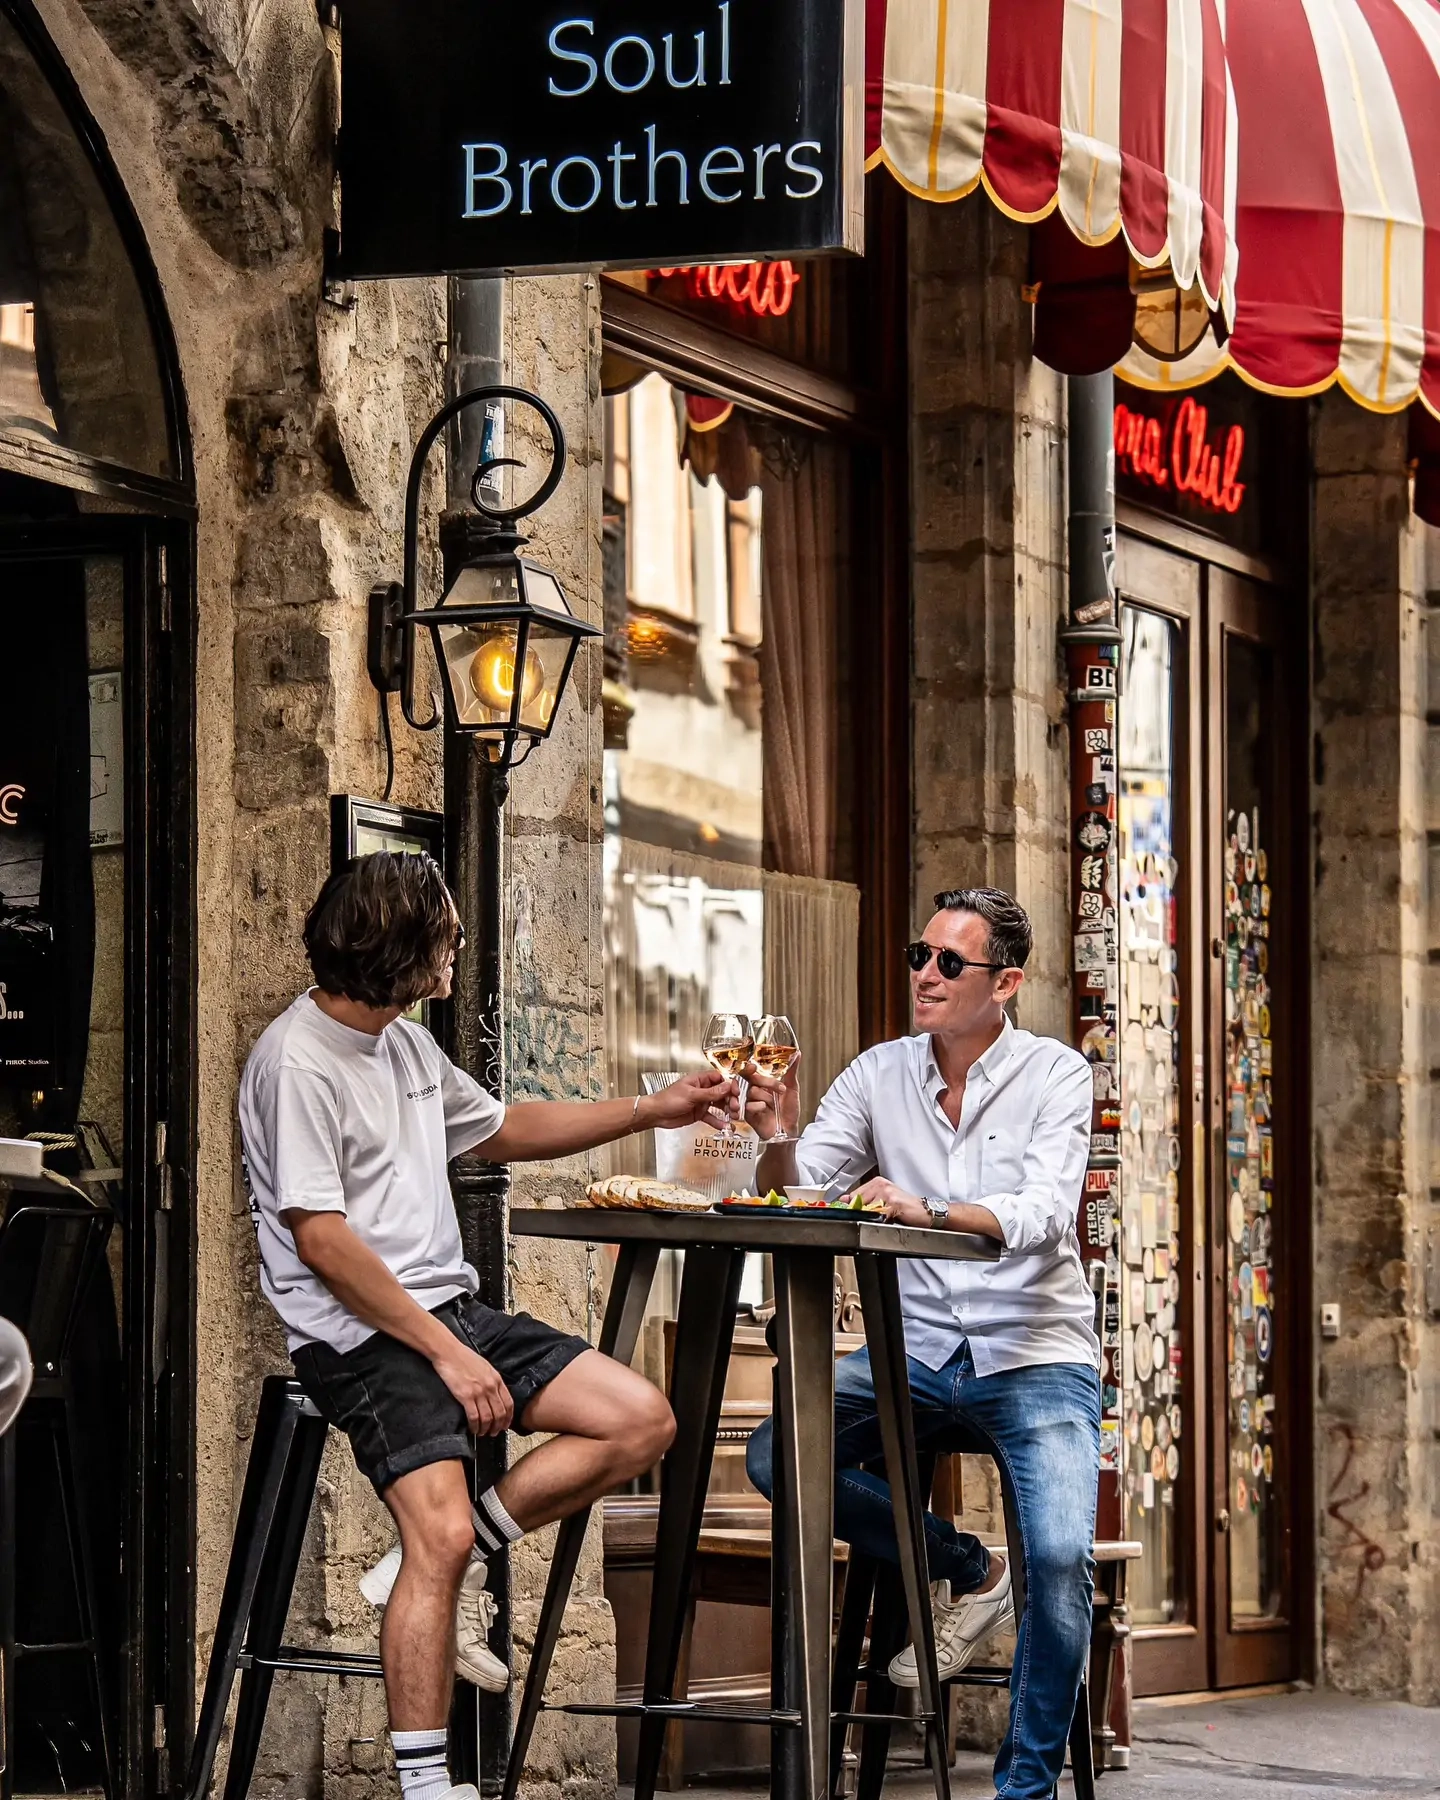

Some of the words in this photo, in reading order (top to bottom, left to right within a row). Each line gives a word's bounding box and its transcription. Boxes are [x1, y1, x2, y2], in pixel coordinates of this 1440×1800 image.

[548, 1, 732, 97] Soul
[461, 123, 825, 219] Brothers
[693, 1148, 752, 1160] PROVENCE
[694, 1138, 753, 1151] ULTIMATE
[1086, 1202, 1099, 1245] STERO
